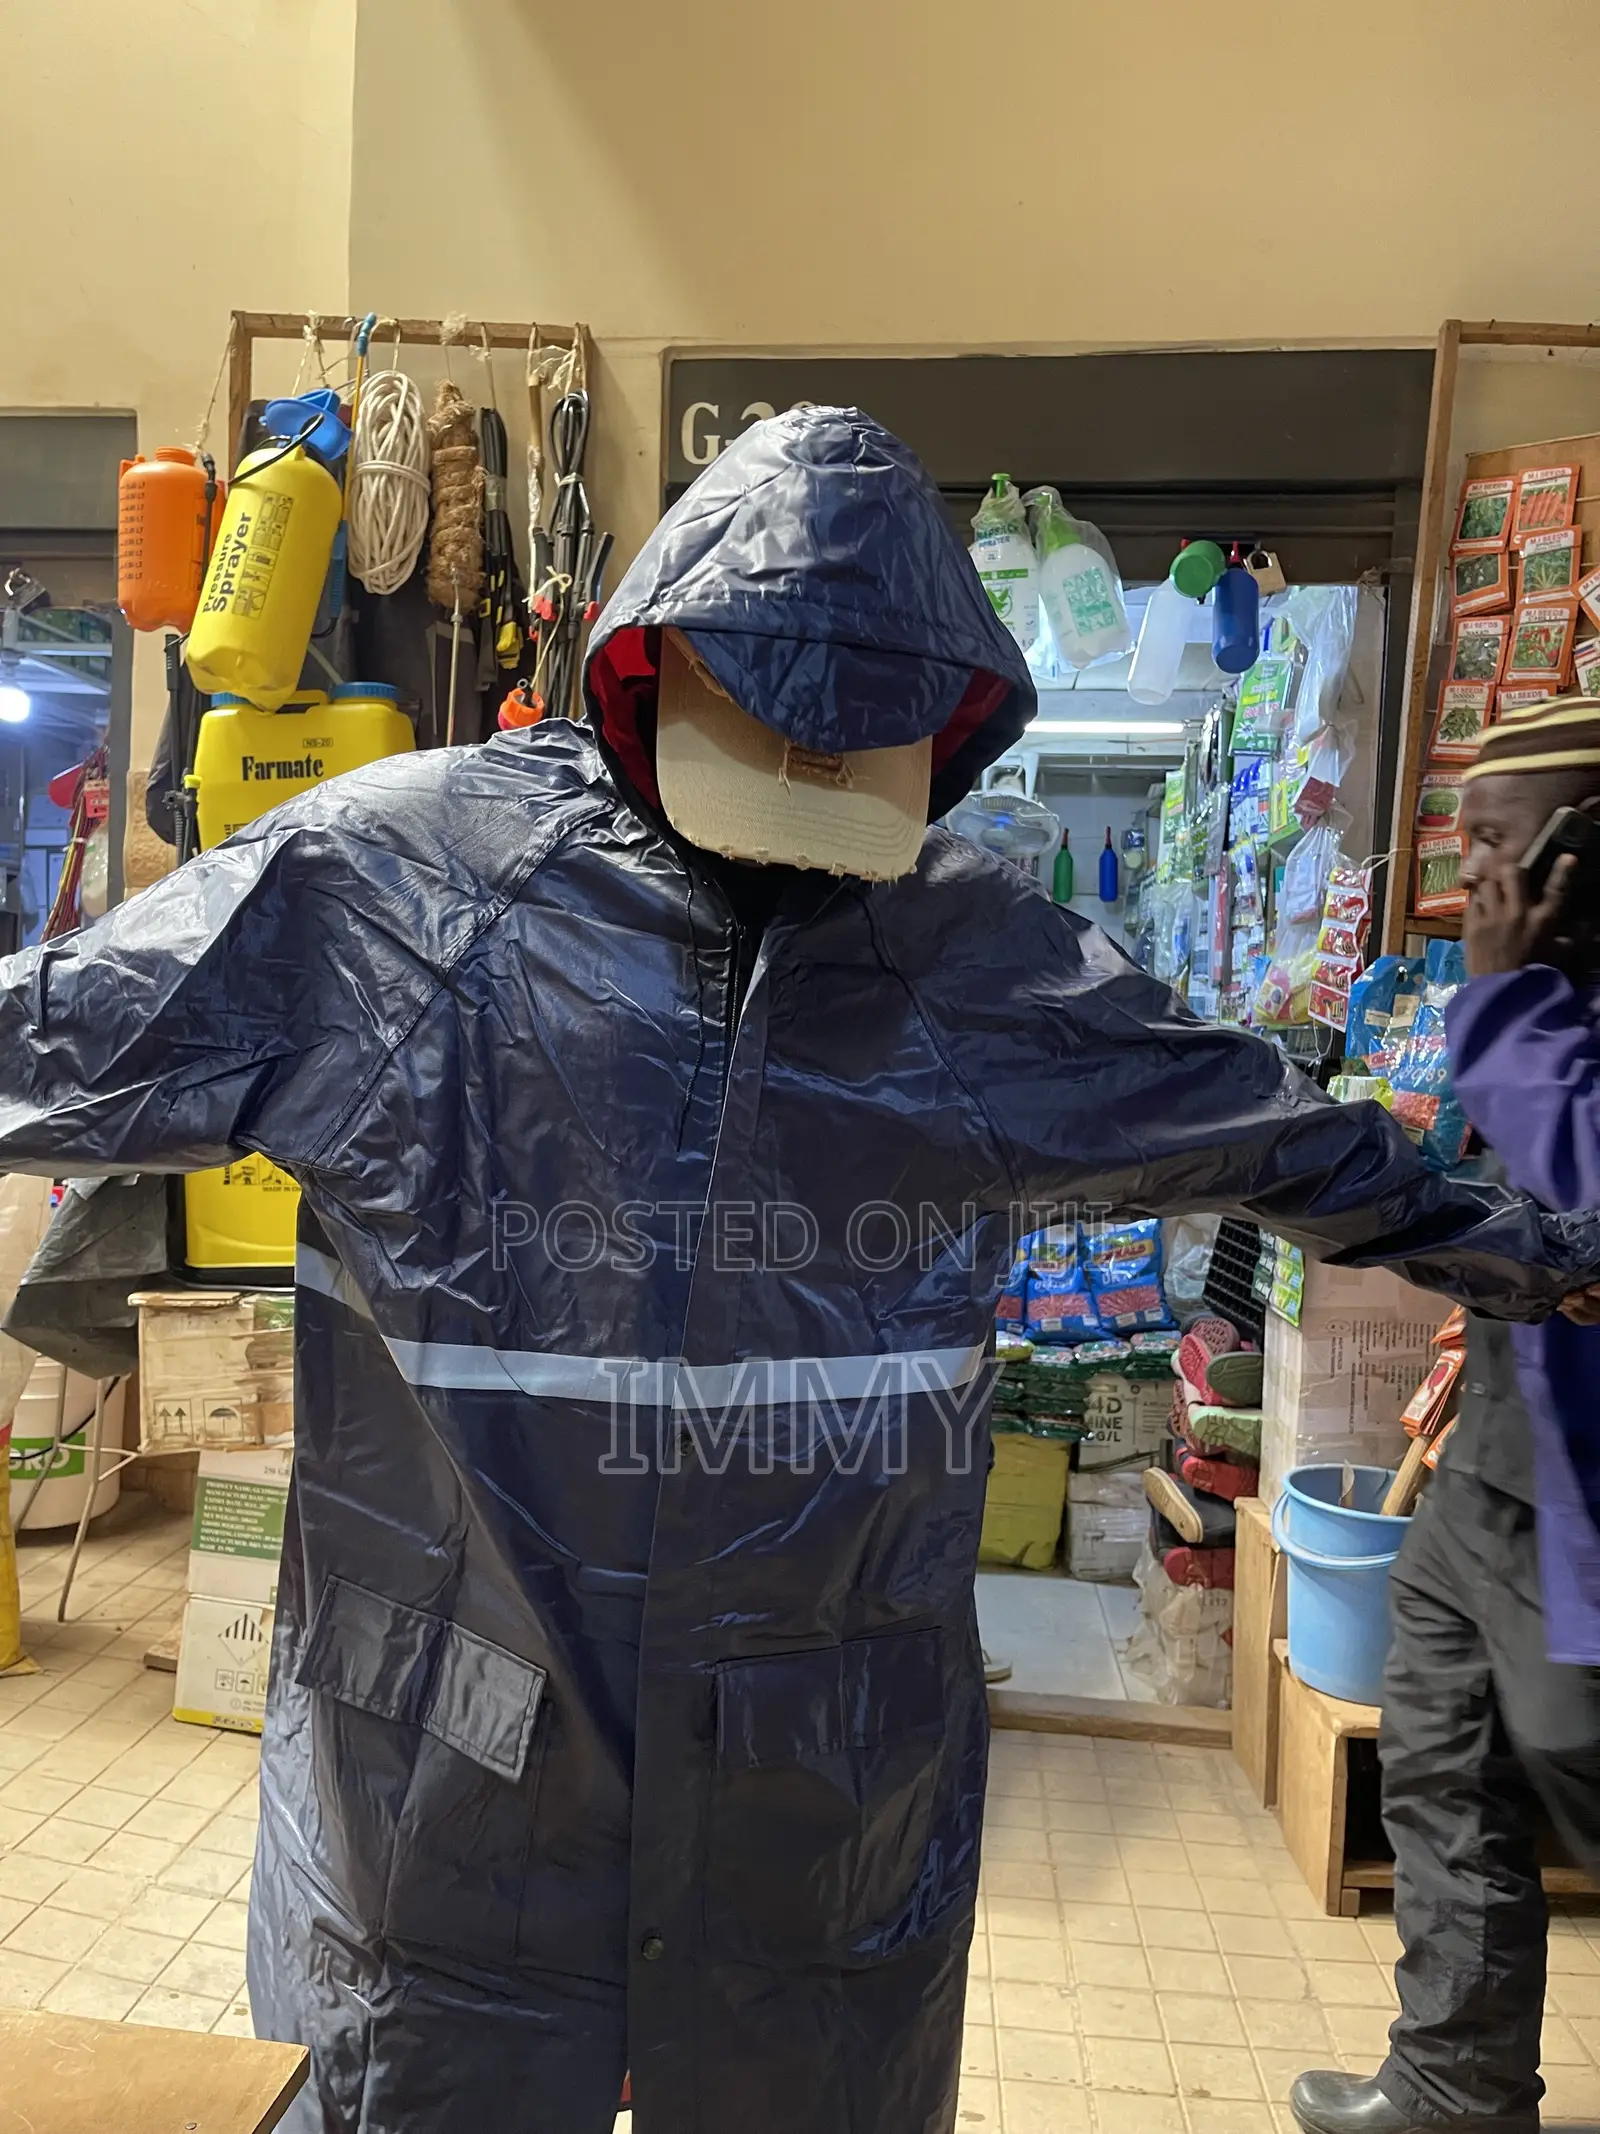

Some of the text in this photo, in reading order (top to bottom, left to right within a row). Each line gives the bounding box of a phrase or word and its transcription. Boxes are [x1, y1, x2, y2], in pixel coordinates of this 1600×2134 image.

[203, 533, 232, 613] Pressure
[212, 512, 252, 613] Sprayer
[242, 753, 324, 781] Farmate
